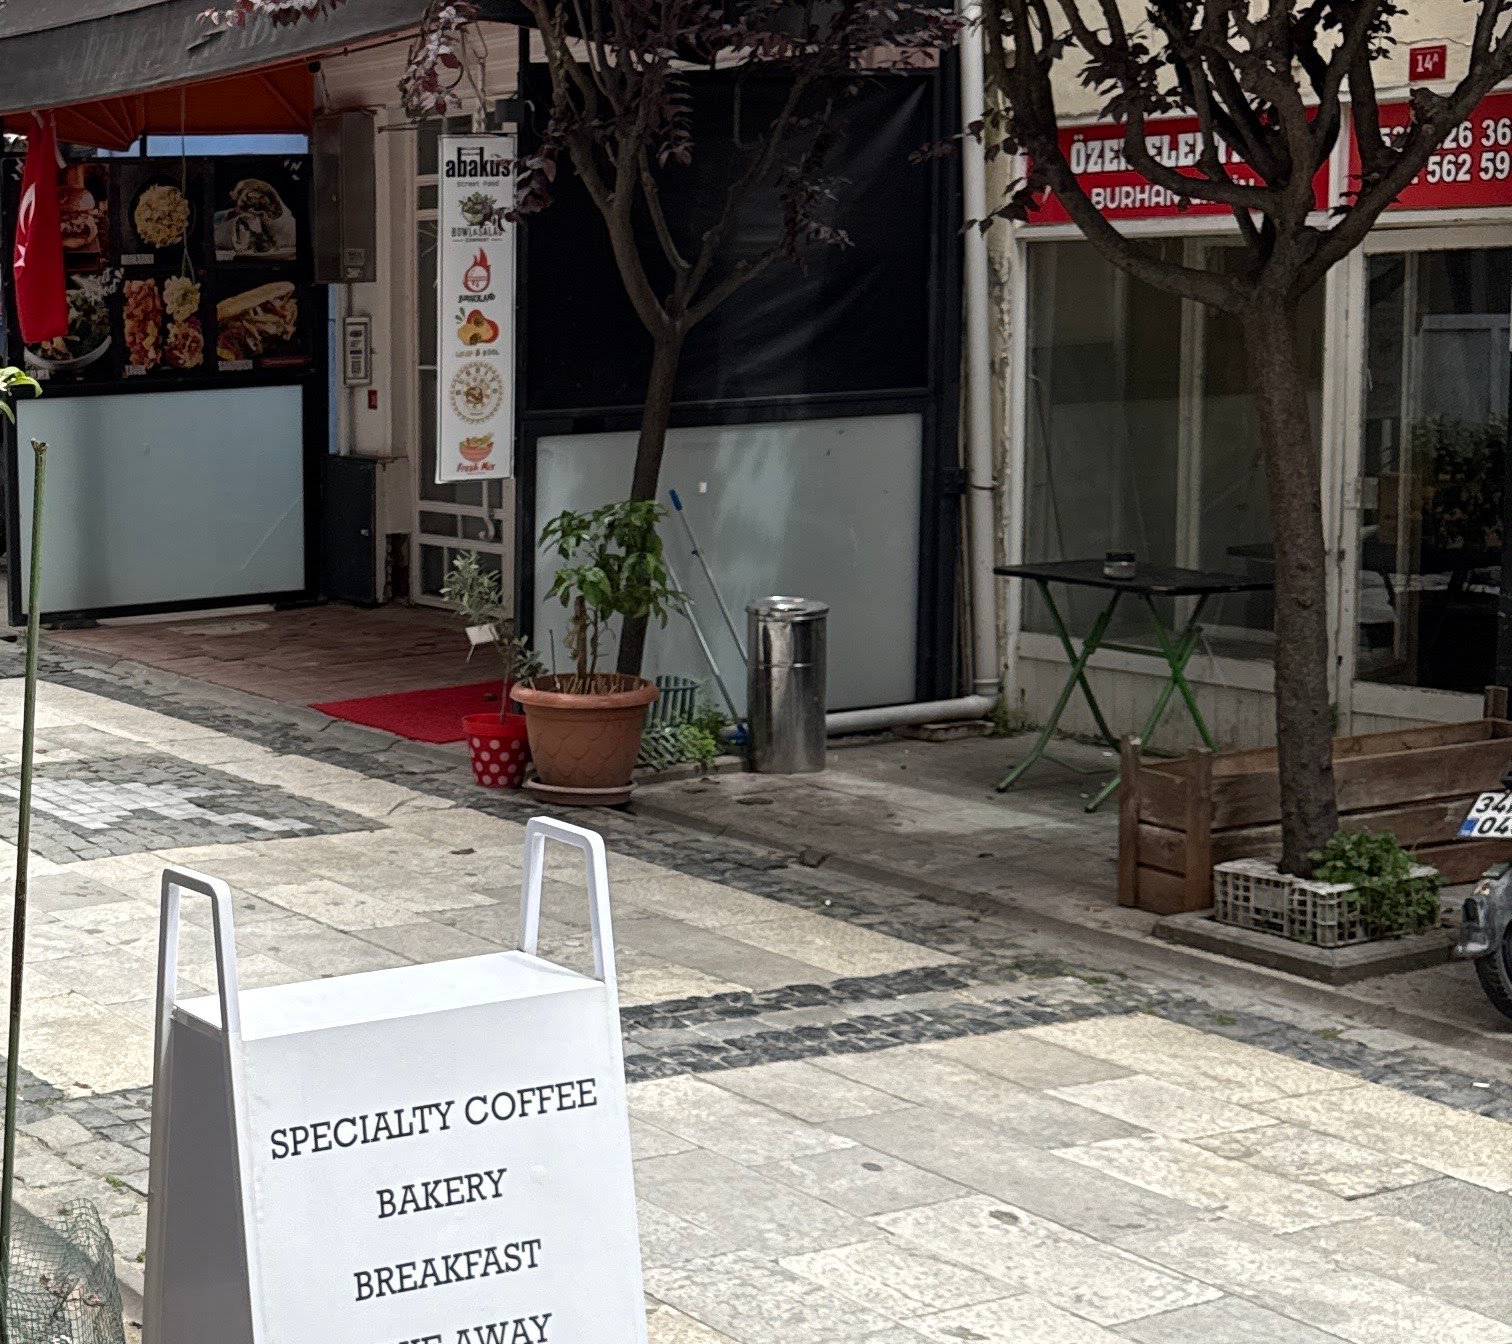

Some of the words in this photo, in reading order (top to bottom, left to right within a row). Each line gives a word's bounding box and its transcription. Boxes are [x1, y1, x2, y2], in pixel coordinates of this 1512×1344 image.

[1480, 117, 1512, 147] 36
[445, 147, 511, 178] abakus
[1426, 152, 1472, 184] 562
[1478, 150, 1512, 181] 59
[1477, 816, 1512, 835] 04
[271, 1100, 455, 1160] SPECIALTY
[464, 1077, 598, 1126] COFFEE
[376, 1167, 508, 1219] BAKERY
[353, 1238, 542, 1302] BREAKFAST
